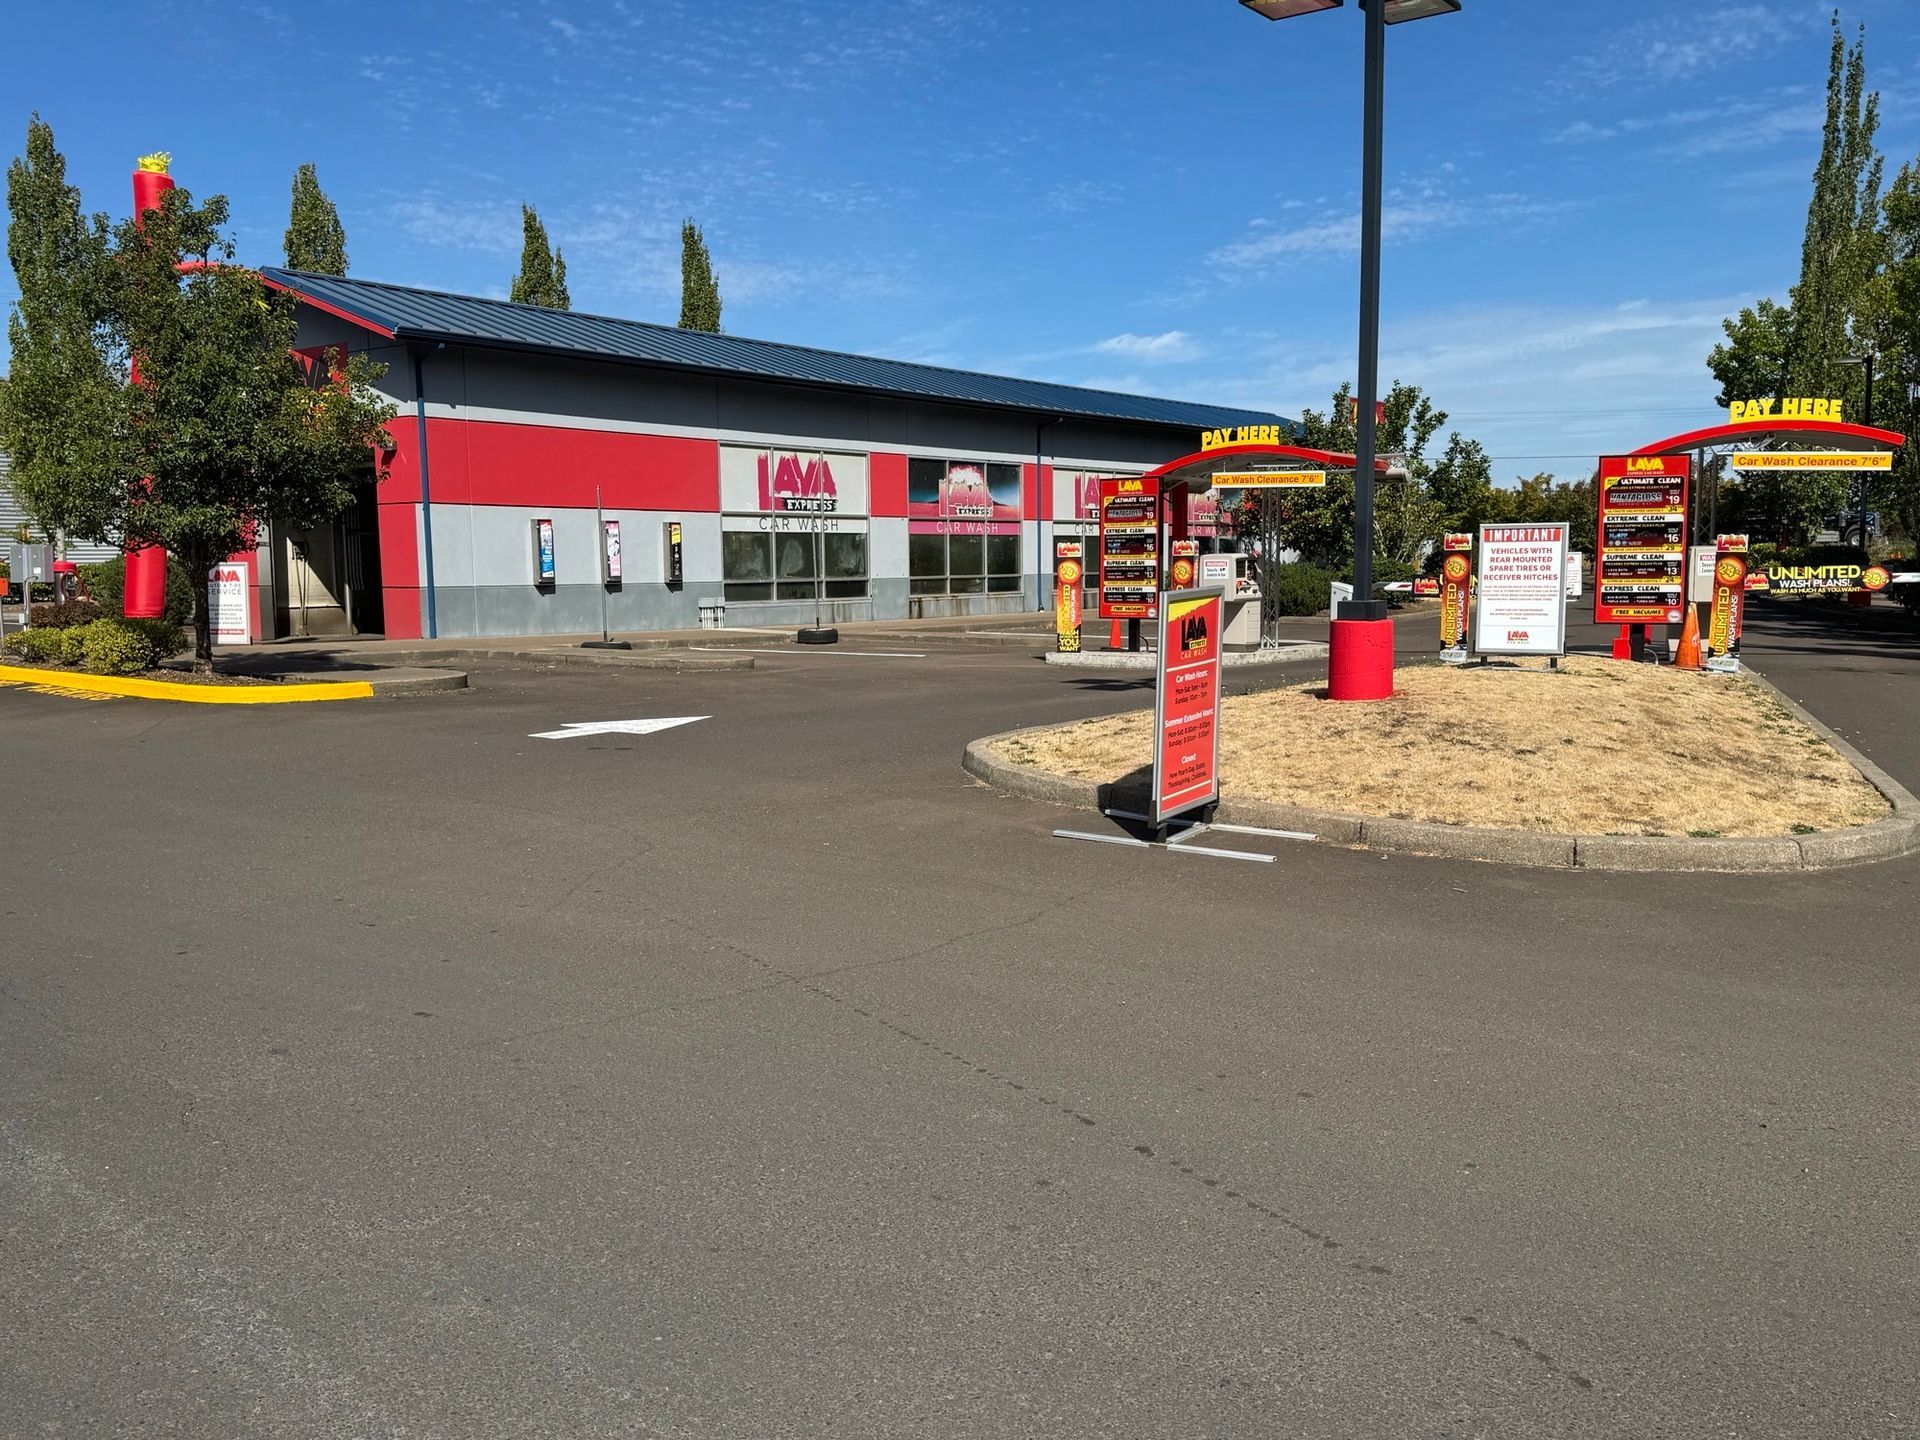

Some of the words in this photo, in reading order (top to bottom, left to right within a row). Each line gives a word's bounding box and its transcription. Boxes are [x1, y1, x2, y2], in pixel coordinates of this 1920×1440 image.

[1730, 399, 1777, 419] PAY
[1782, 398, 1843, 417] HERE
[1202, 428, 1233, 447] PAY
[1237, 425, 1280, 442] HERE
[1627, 457, 1664, 470] LAVA
[1738, 456, 1759, 466] Car
[1762, 456, 1794, 466] Wash
[1798, 456, 1858, 466] Clearance
[757, 452, 838, 511] LAVA
[1118, 480, 1143, 492] LAVA
[1215, 476, 1229, 485] Car
[1232, 475, 1255, 484] Wash
[1257, 474, 1299, 484] Clearance
[1075, 473, 1100, 519] LA
[787, 500, 833, 511] EXPRESS
[759, 517, 790, 531] CAR
[798, 518, 839, 531] WASH
[936, 521, 961, 533] CAR
[966, 522, 999, 533] WASH
[1075, 524, 1094, 535] CAR
[1444, 534, 1470, 550] LAVA
[1489, 528, 1555, 542] IMPORTANT
[1058, 543, 1081, 556] LAVA
[1717, 534, 1747, 551] LAVA
[209, 569, 240, 582] AVA
[1769, 566, 1861, 580] UNLIMITED
[1414, 578, 1438, 594] LAVA
[1780, 580, 1810, 588] WASH
[1445, 583, 1458, 648] UNLIMITED
[1713, 587, 1730, 656] UNLIMITED
[1182, 615, 1208, 652] LAVA
[1508, 630, 1529, 641] LAVA
[1728, 624, 1736, 648] WASH
[1180, 650, 1192, 660] CAR
[1194, 648, 1207, 656] WASH
[1176, 675, 1184, 684] Car
[1184, 672, 1196, 681] Wash
[1165, 718, 1184, 728] Summer
[1184, 710, 1202, 723] Extended
